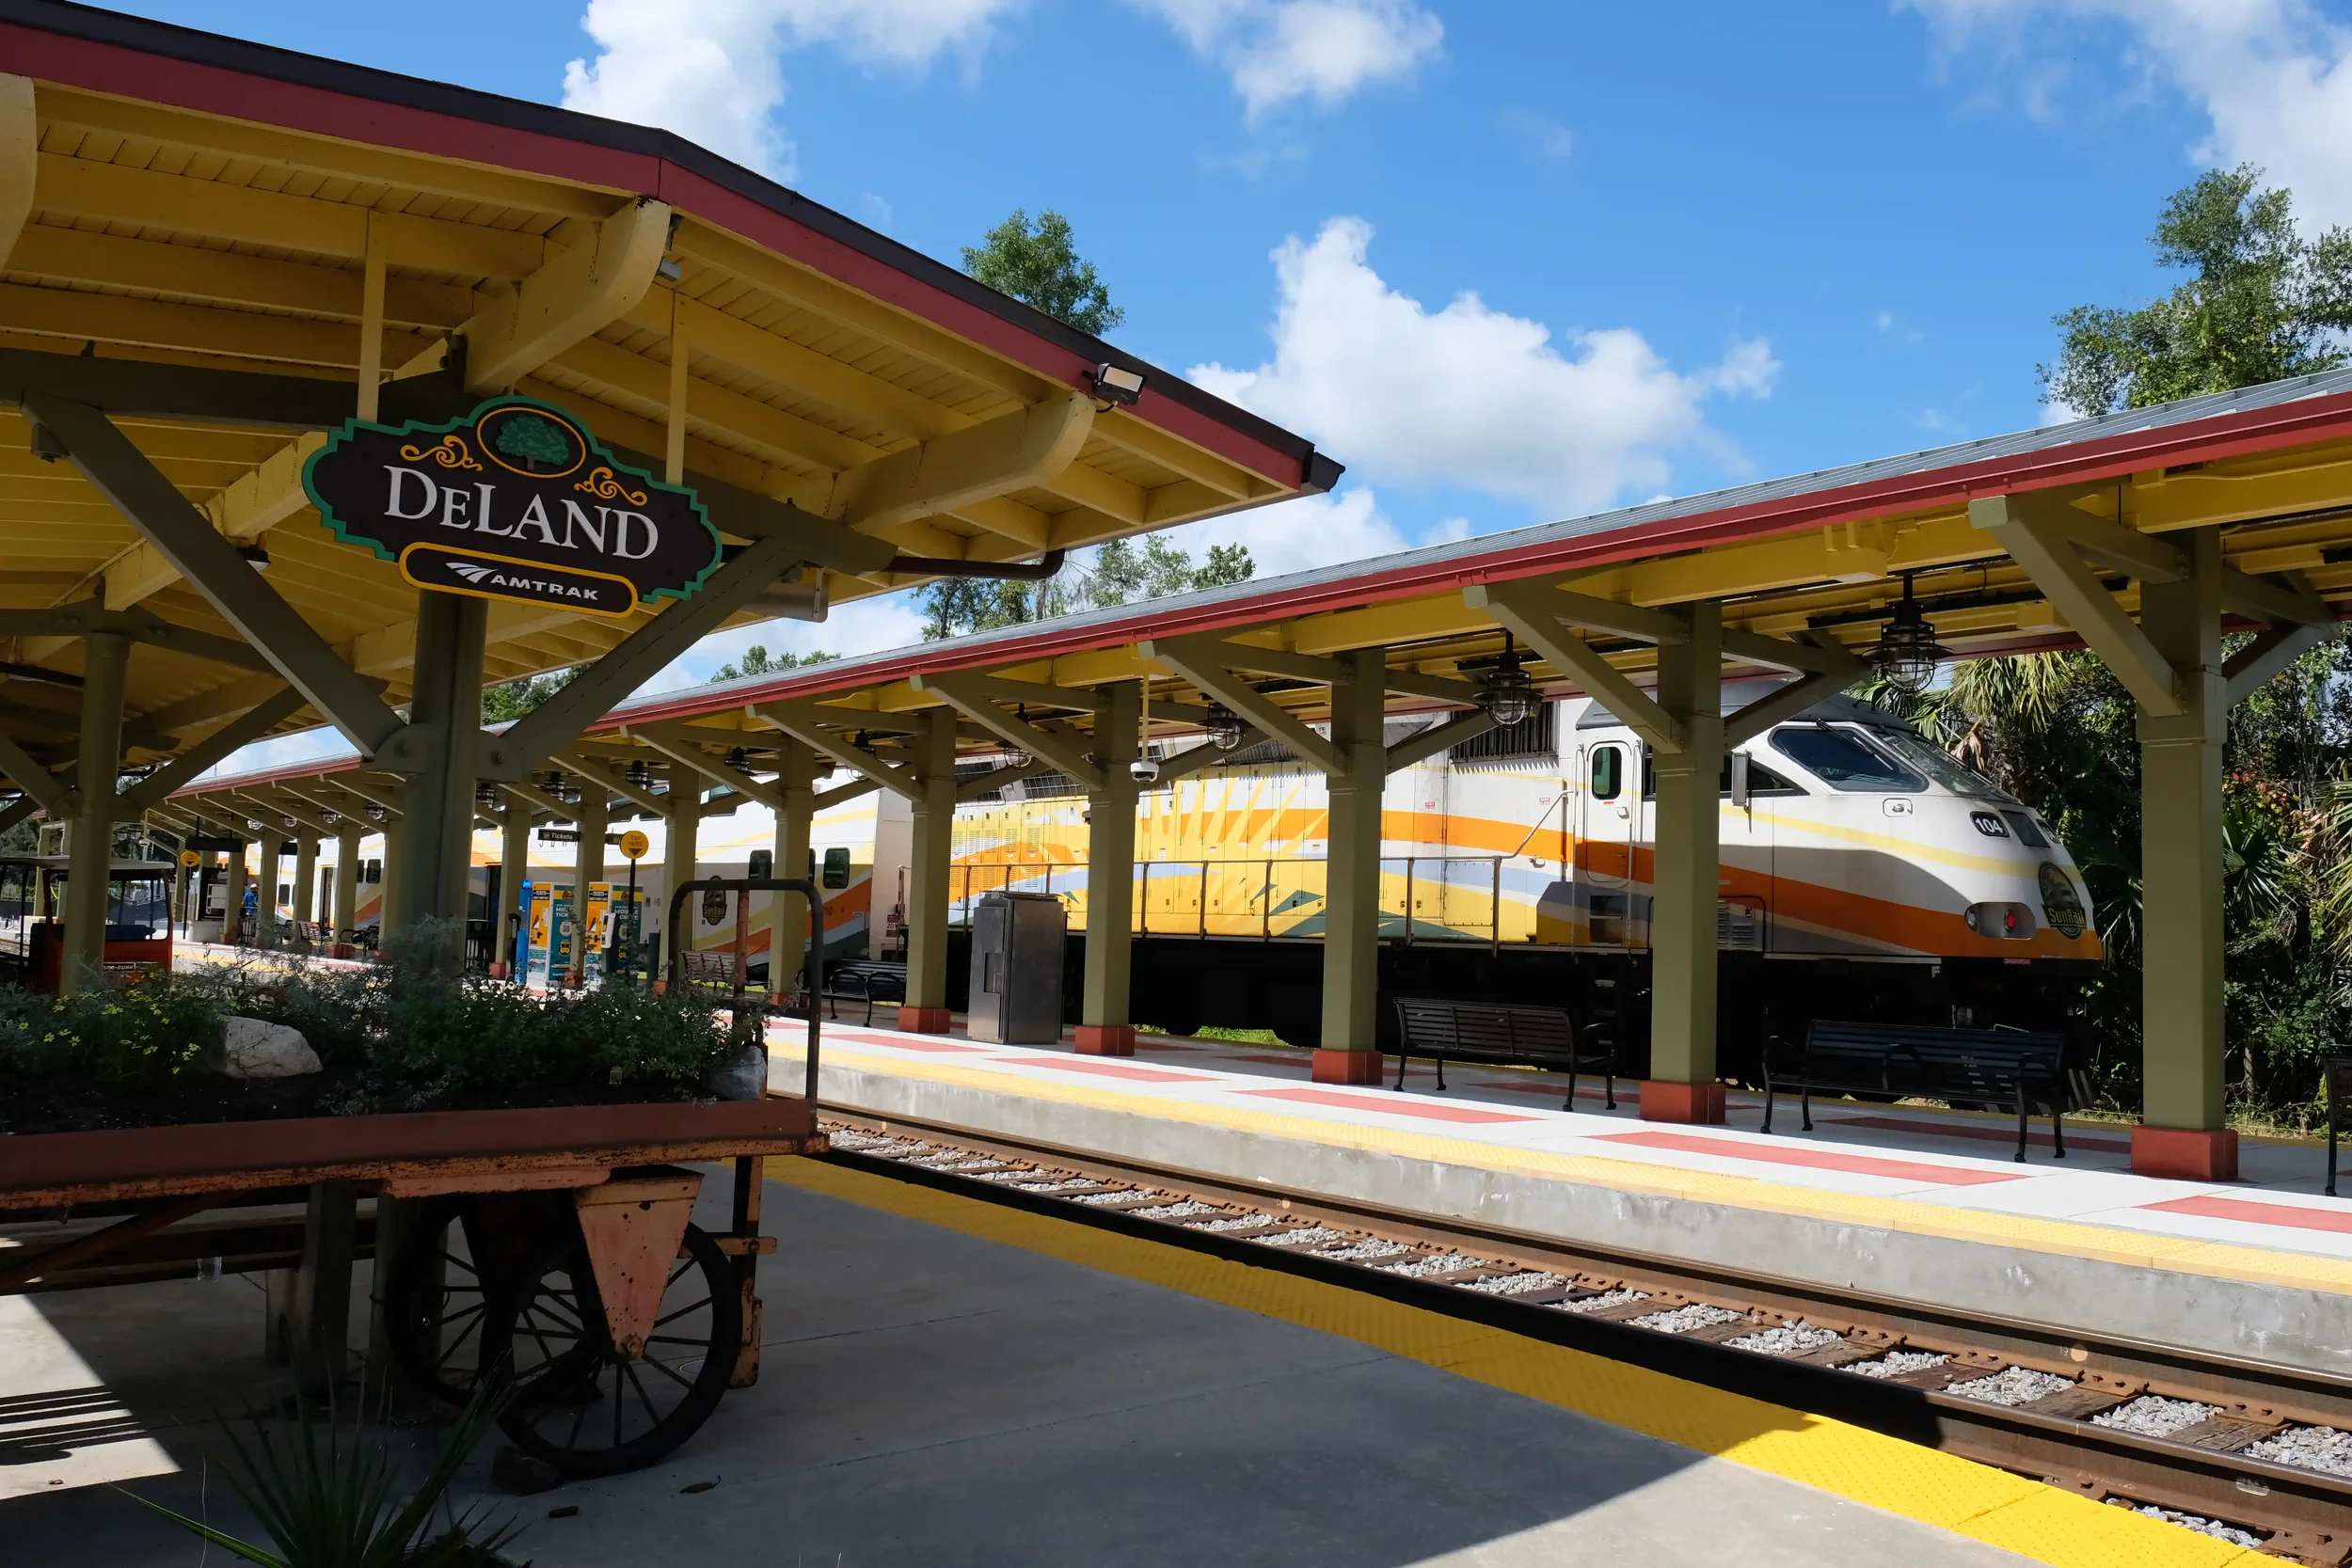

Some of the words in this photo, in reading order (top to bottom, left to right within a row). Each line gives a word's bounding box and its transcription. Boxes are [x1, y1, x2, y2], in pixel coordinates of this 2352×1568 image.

[490, 574, 598, 601] AMTRAK
[1976, 817, 2003, 834] 104
[550, 832, 573, 840] Tickets
[704, 905, 725, 915] SunRail
[2048, 907, 2085, 925] SunRail
[1931, 965, 1941, 978] F
